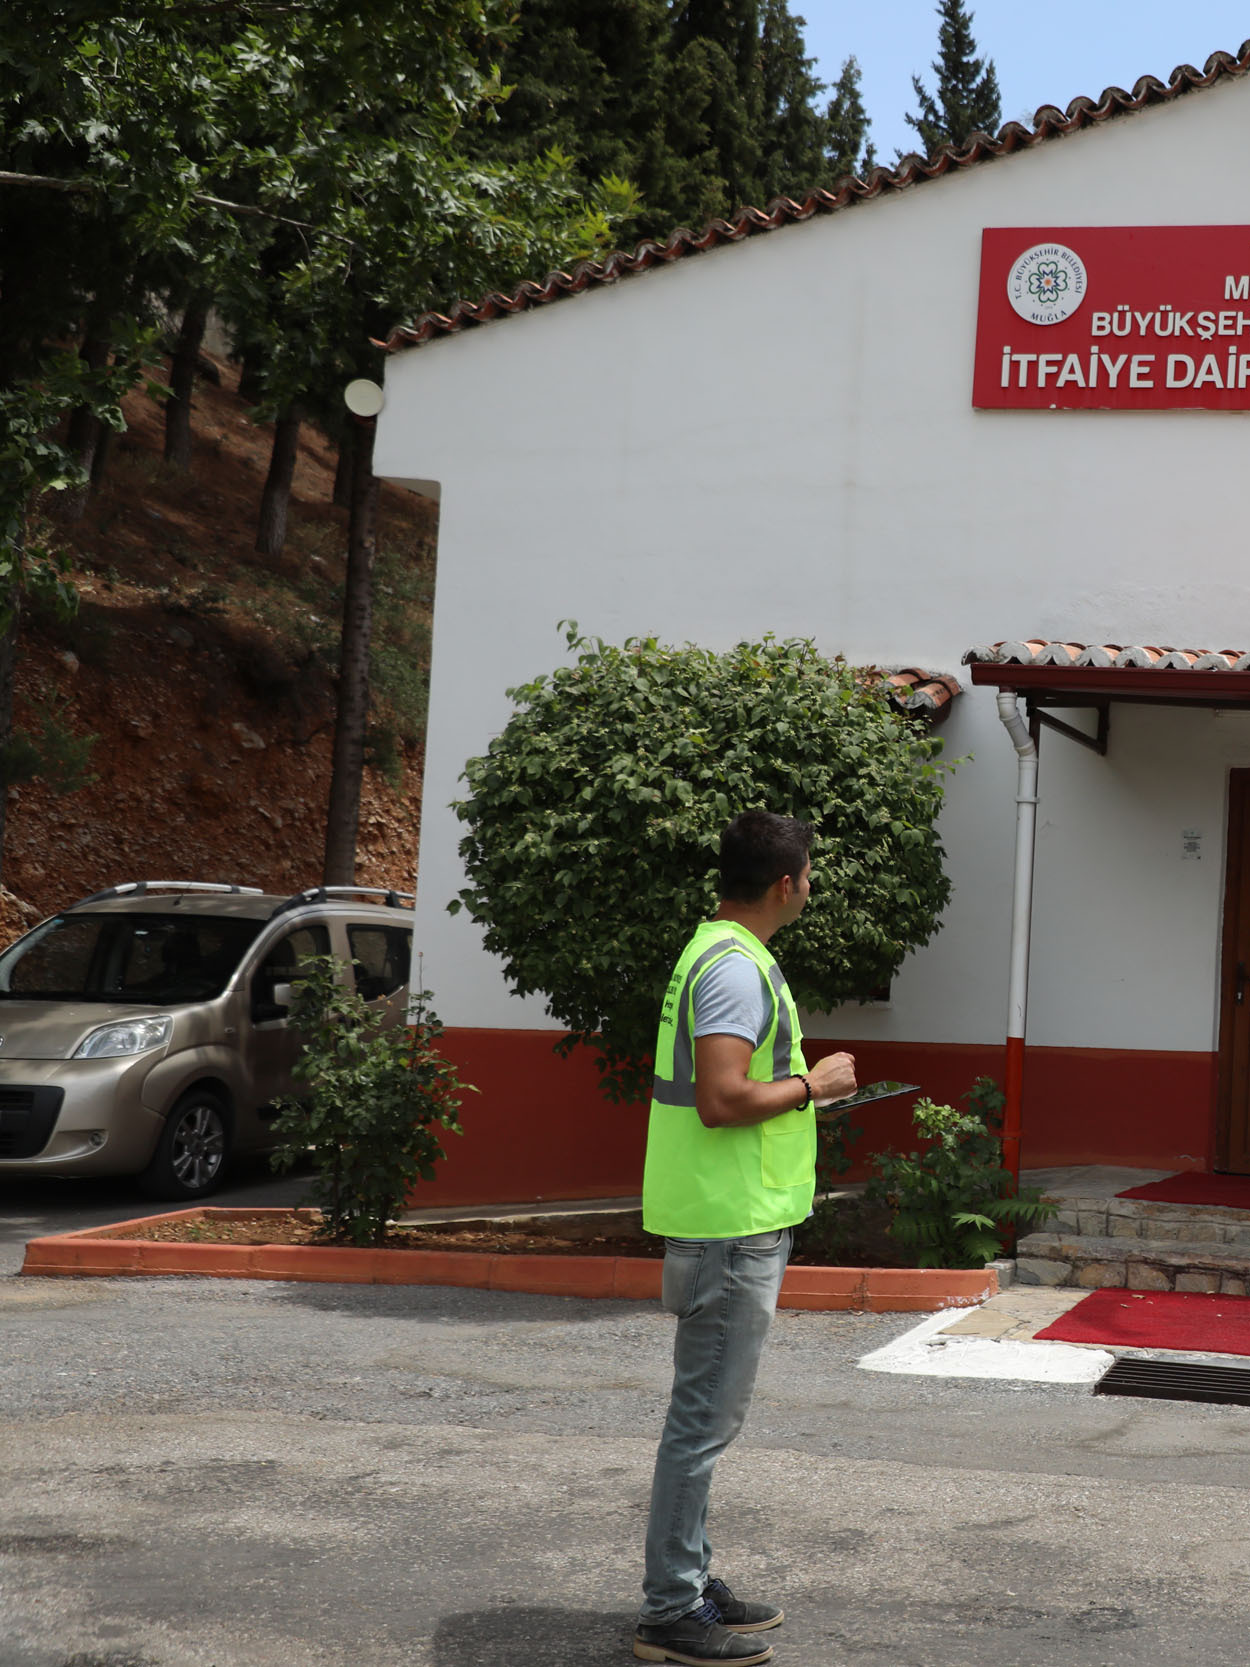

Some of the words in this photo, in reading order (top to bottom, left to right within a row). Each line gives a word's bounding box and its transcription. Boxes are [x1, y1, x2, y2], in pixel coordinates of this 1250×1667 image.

[1016, 247, 1059, 281] BÜYÜKŞEHİR
[1061, 251, 1084, 295] BELEDİYESİ
[1031, 310, 1067, 322] MUĞLA
[1000, 346, 1155, 388] İTFAİYE
